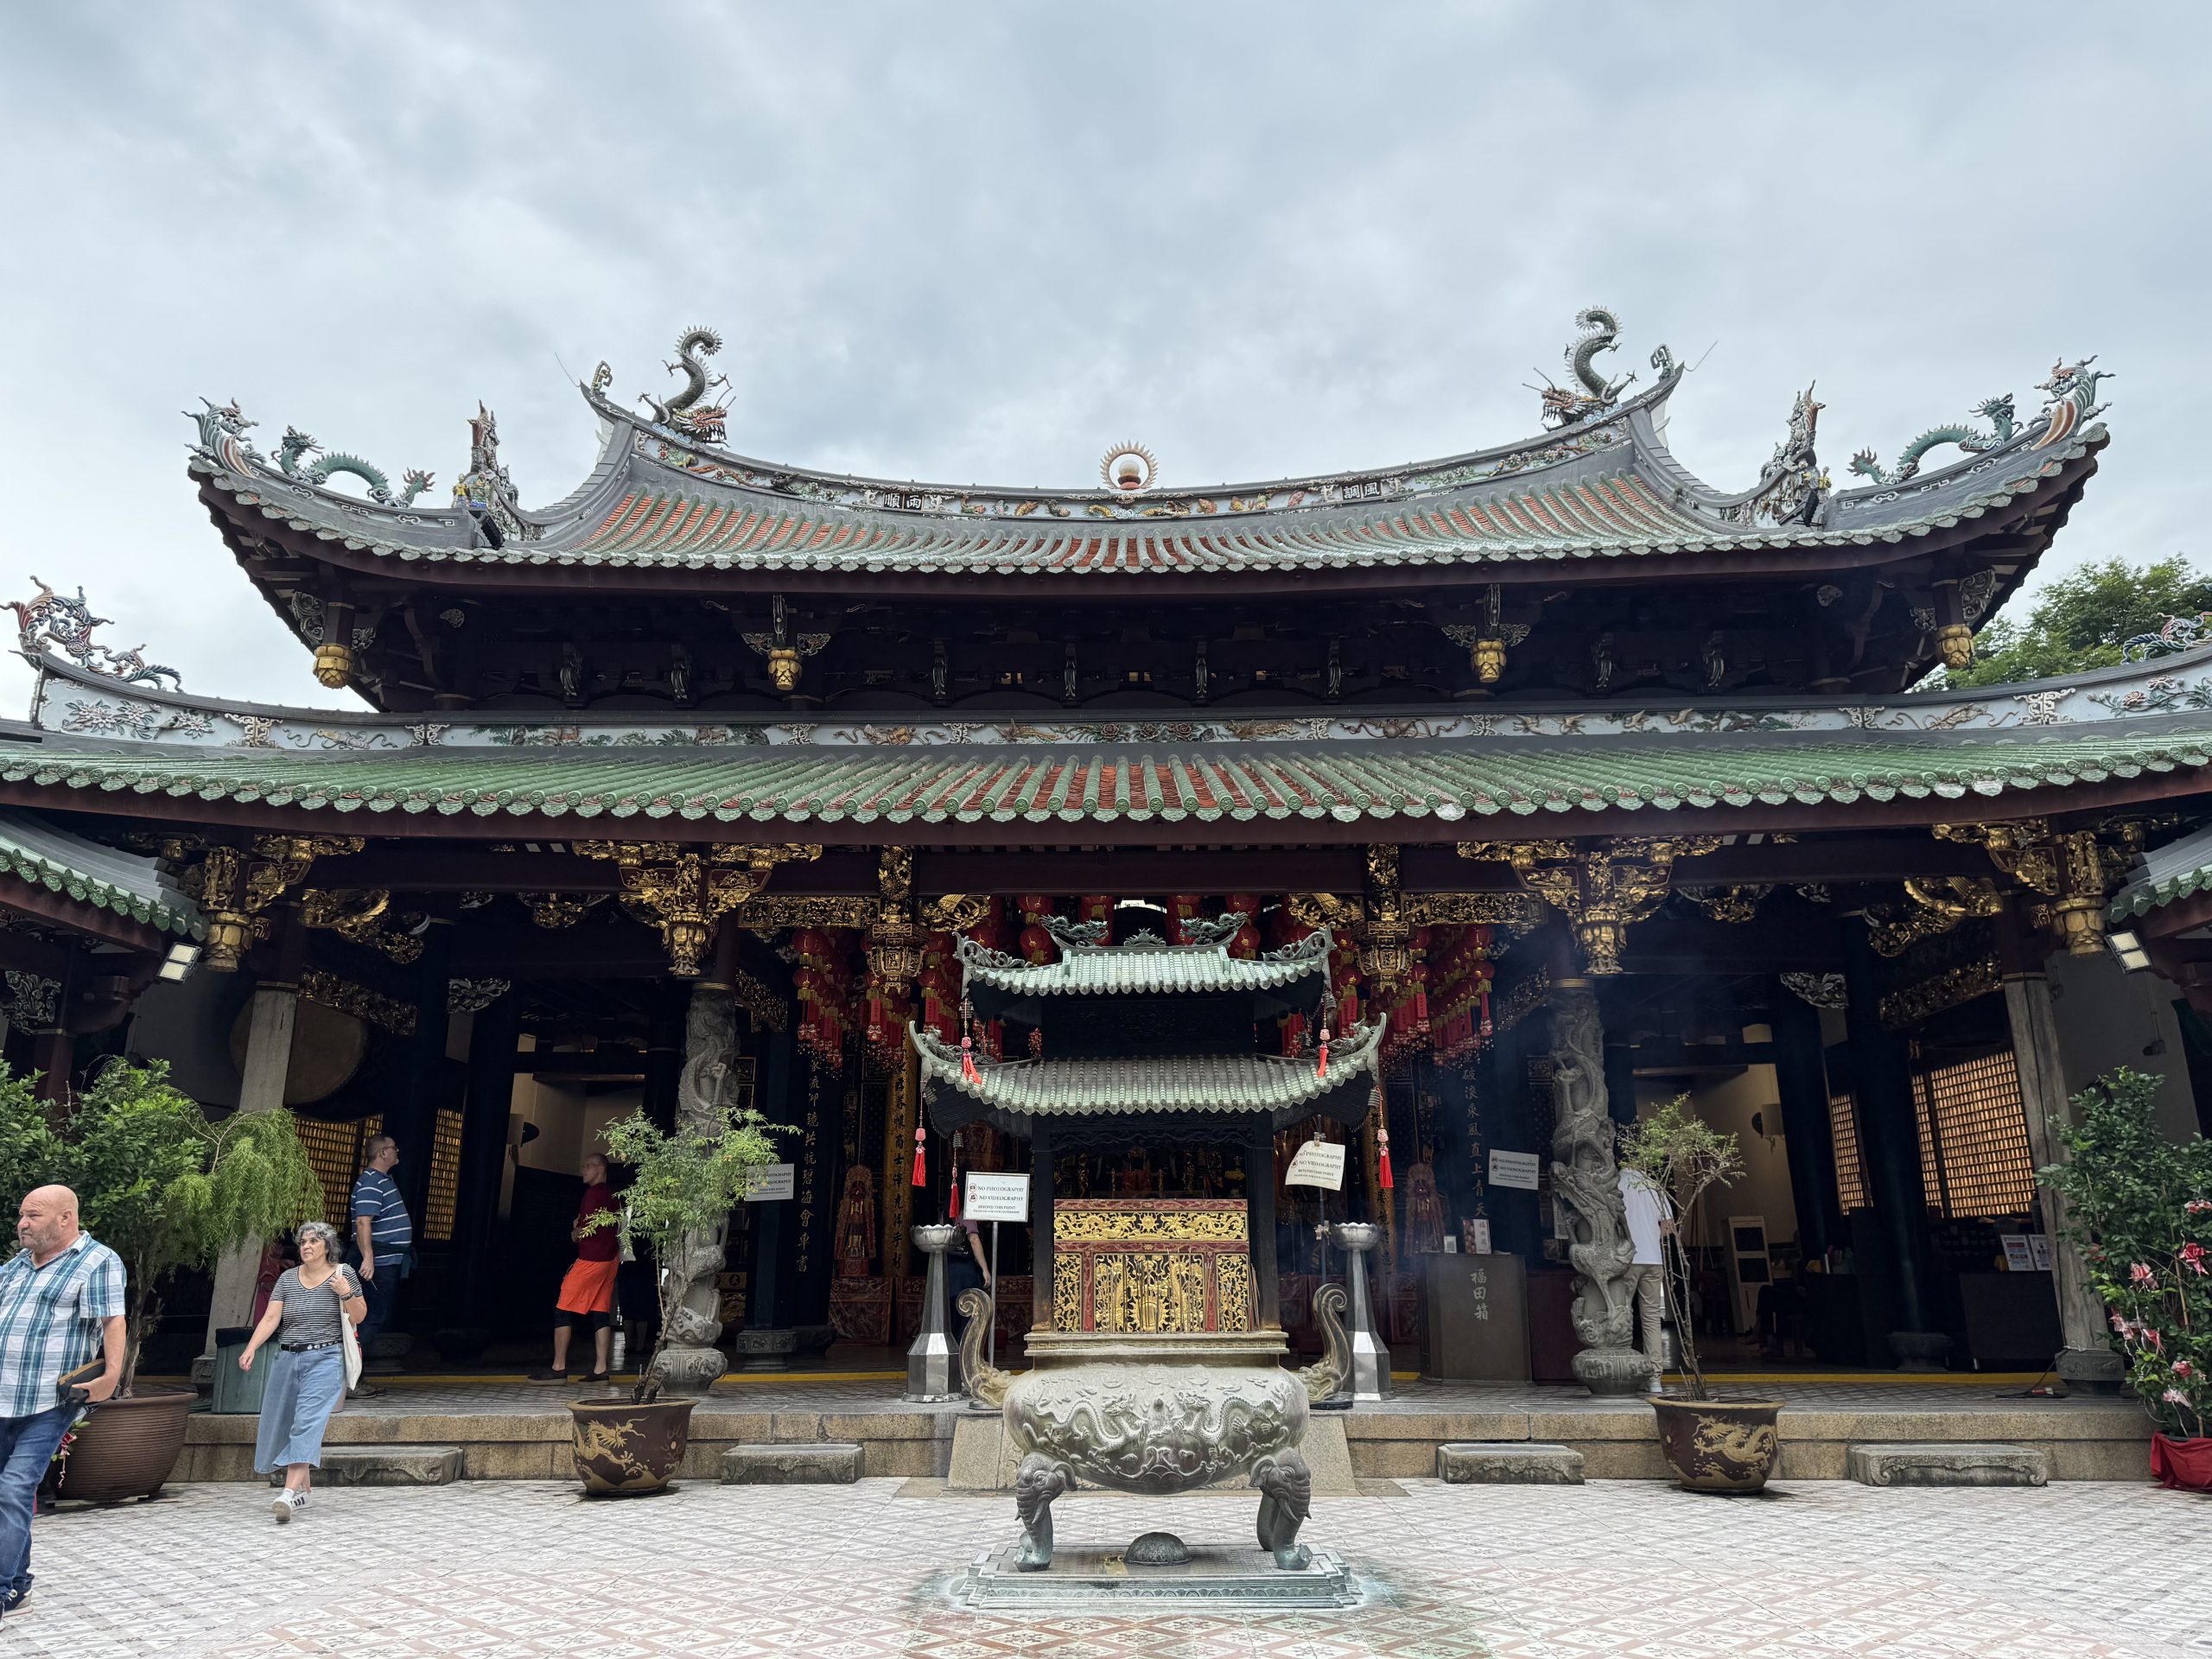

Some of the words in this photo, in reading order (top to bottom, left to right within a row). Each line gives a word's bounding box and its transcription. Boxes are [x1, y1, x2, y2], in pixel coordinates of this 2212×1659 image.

[1306, 1152, 1341, 1160] PHOTOGRAPHY
[1308, 1161, 1341, 1169] VIDEOGRAPHY
[1469, 1268, 1489, 1321] 福田箱
